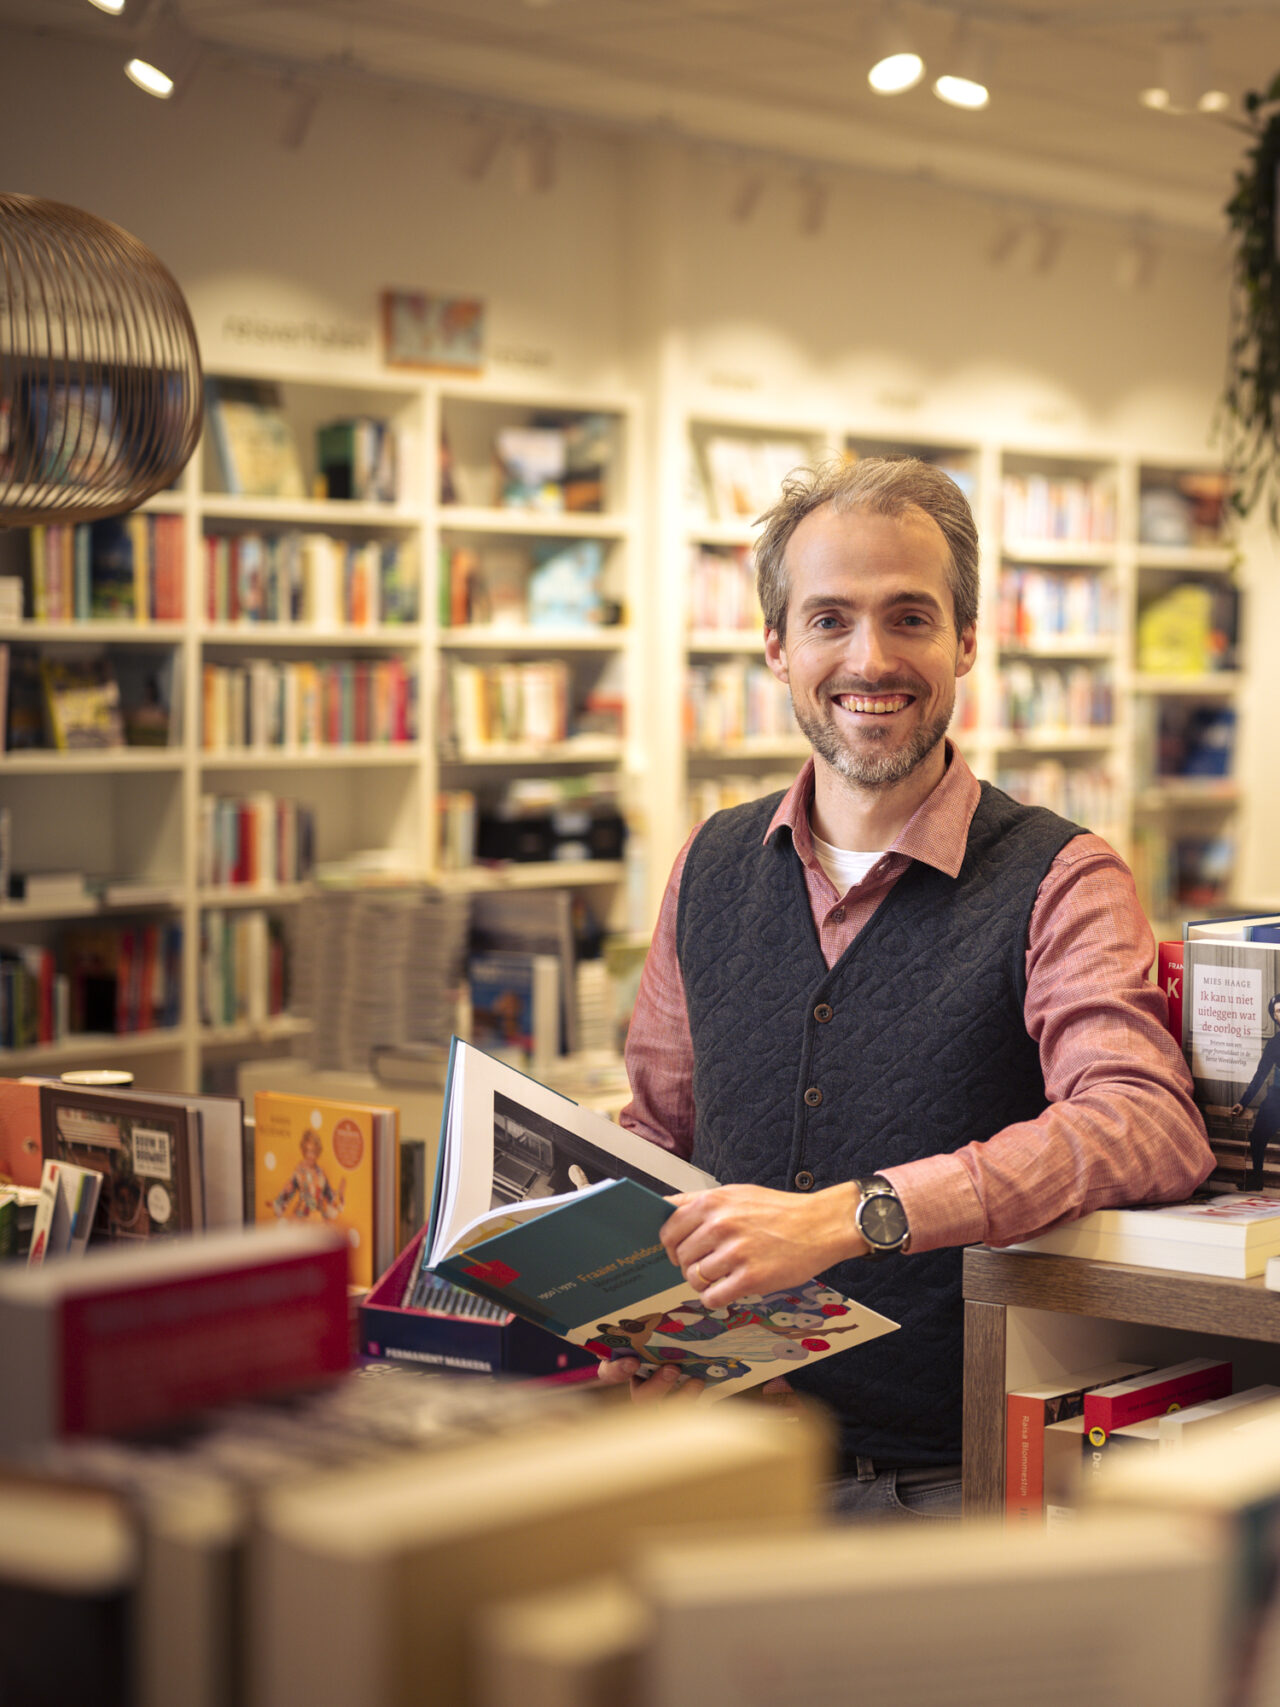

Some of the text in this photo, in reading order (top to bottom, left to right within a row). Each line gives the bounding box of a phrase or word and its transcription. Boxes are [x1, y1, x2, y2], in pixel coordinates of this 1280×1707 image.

[1203, 977, 1251, 988] MIES HAAGE
[1200, 991, 1253, 1006] Ik kan u niet
[1198, 1008, 1256, 1021] uitleggen wat
[1202, 1021, 1251, 1037] de oorlog is
[1021, 1416, 1030, 1440] Raisa
[1019, 1442, 1030, 1497] Blommestijn
